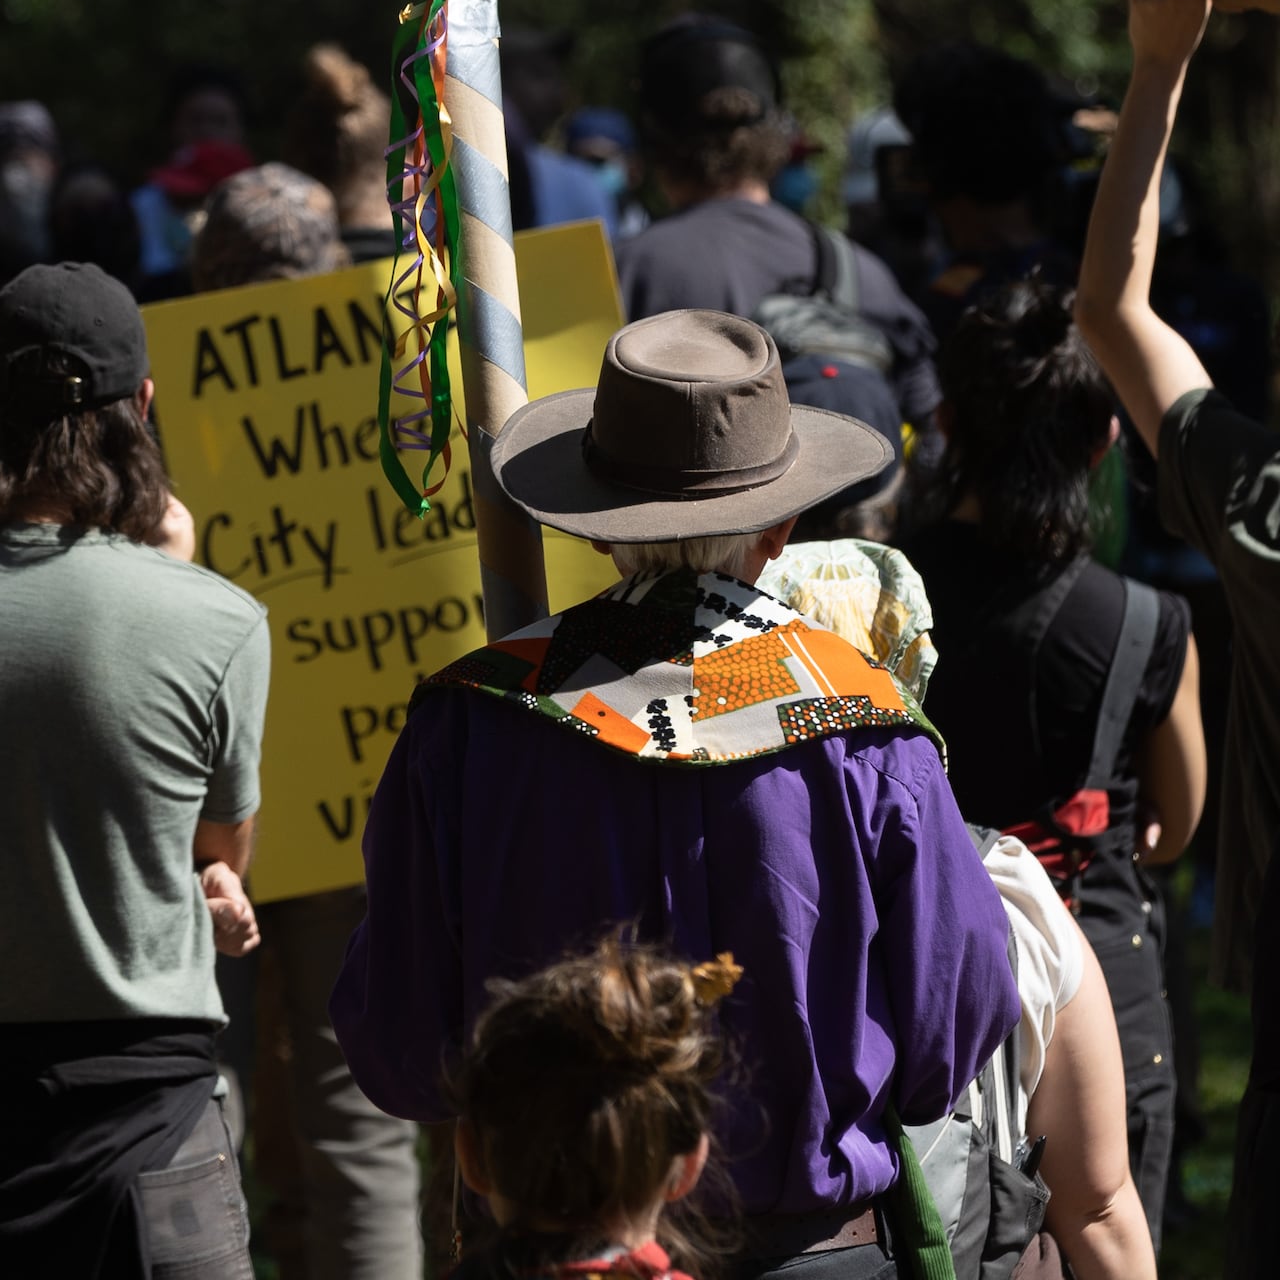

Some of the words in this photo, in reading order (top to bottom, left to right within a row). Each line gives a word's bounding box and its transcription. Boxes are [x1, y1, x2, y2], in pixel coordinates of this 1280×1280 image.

[192, 286, 458, 398] ATLANT
[202, 504, 337, 590] City
[366, 469, 477, 552] lead
[286, 593, 485, 671] suppo
